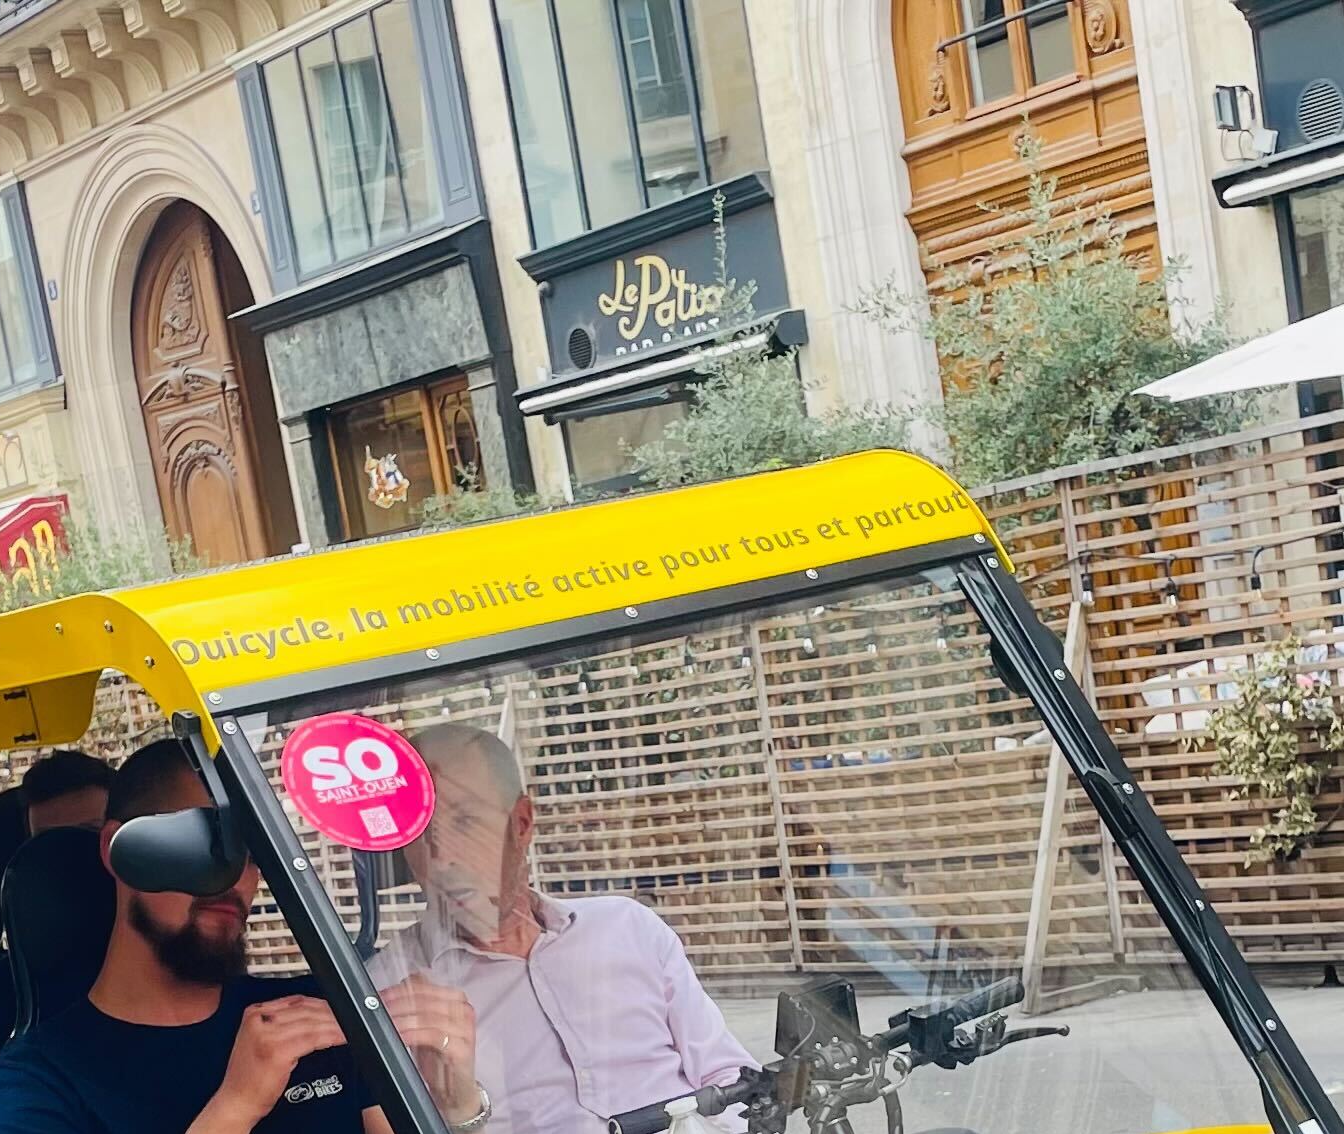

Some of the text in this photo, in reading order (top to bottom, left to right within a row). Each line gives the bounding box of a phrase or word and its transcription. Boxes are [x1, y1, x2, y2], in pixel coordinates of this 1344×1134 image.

[598, 259, 640, 316] Le
[172, 490, 968, 665] Ouicycle, la mobilité active pour tous et partout
[302, 737, 399, 791] SO
